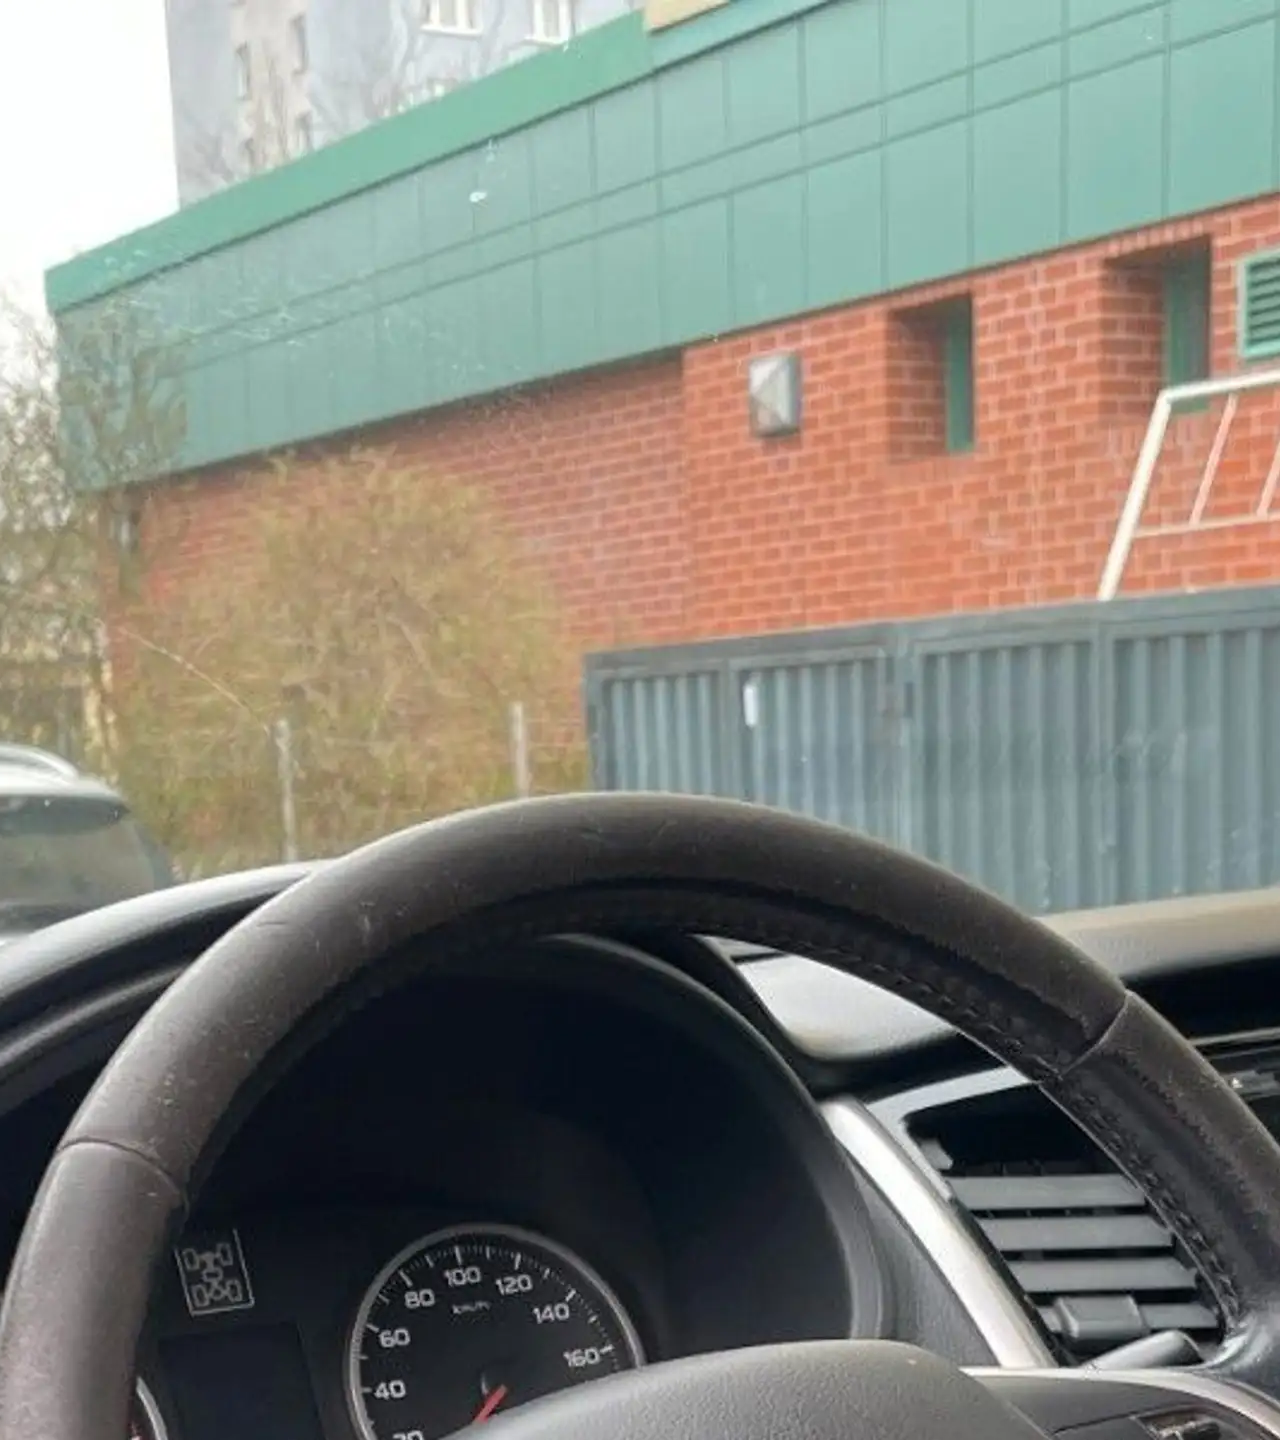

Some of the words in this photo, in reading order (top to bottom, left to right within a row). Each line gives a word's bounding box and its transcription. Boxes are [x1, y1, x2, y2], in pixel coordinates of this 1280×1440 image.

[444, 1266, 482, 1288] 100
[495, 1274, 533, 1296] 120
[404, 1289, 435, 1309] 80
[533, 1303, 570, 1324] 140
[379, 1328, 411, 1348] 60
[563, 1348, 601, 1367] 160
[374, 1380, 406, 1400] 40
